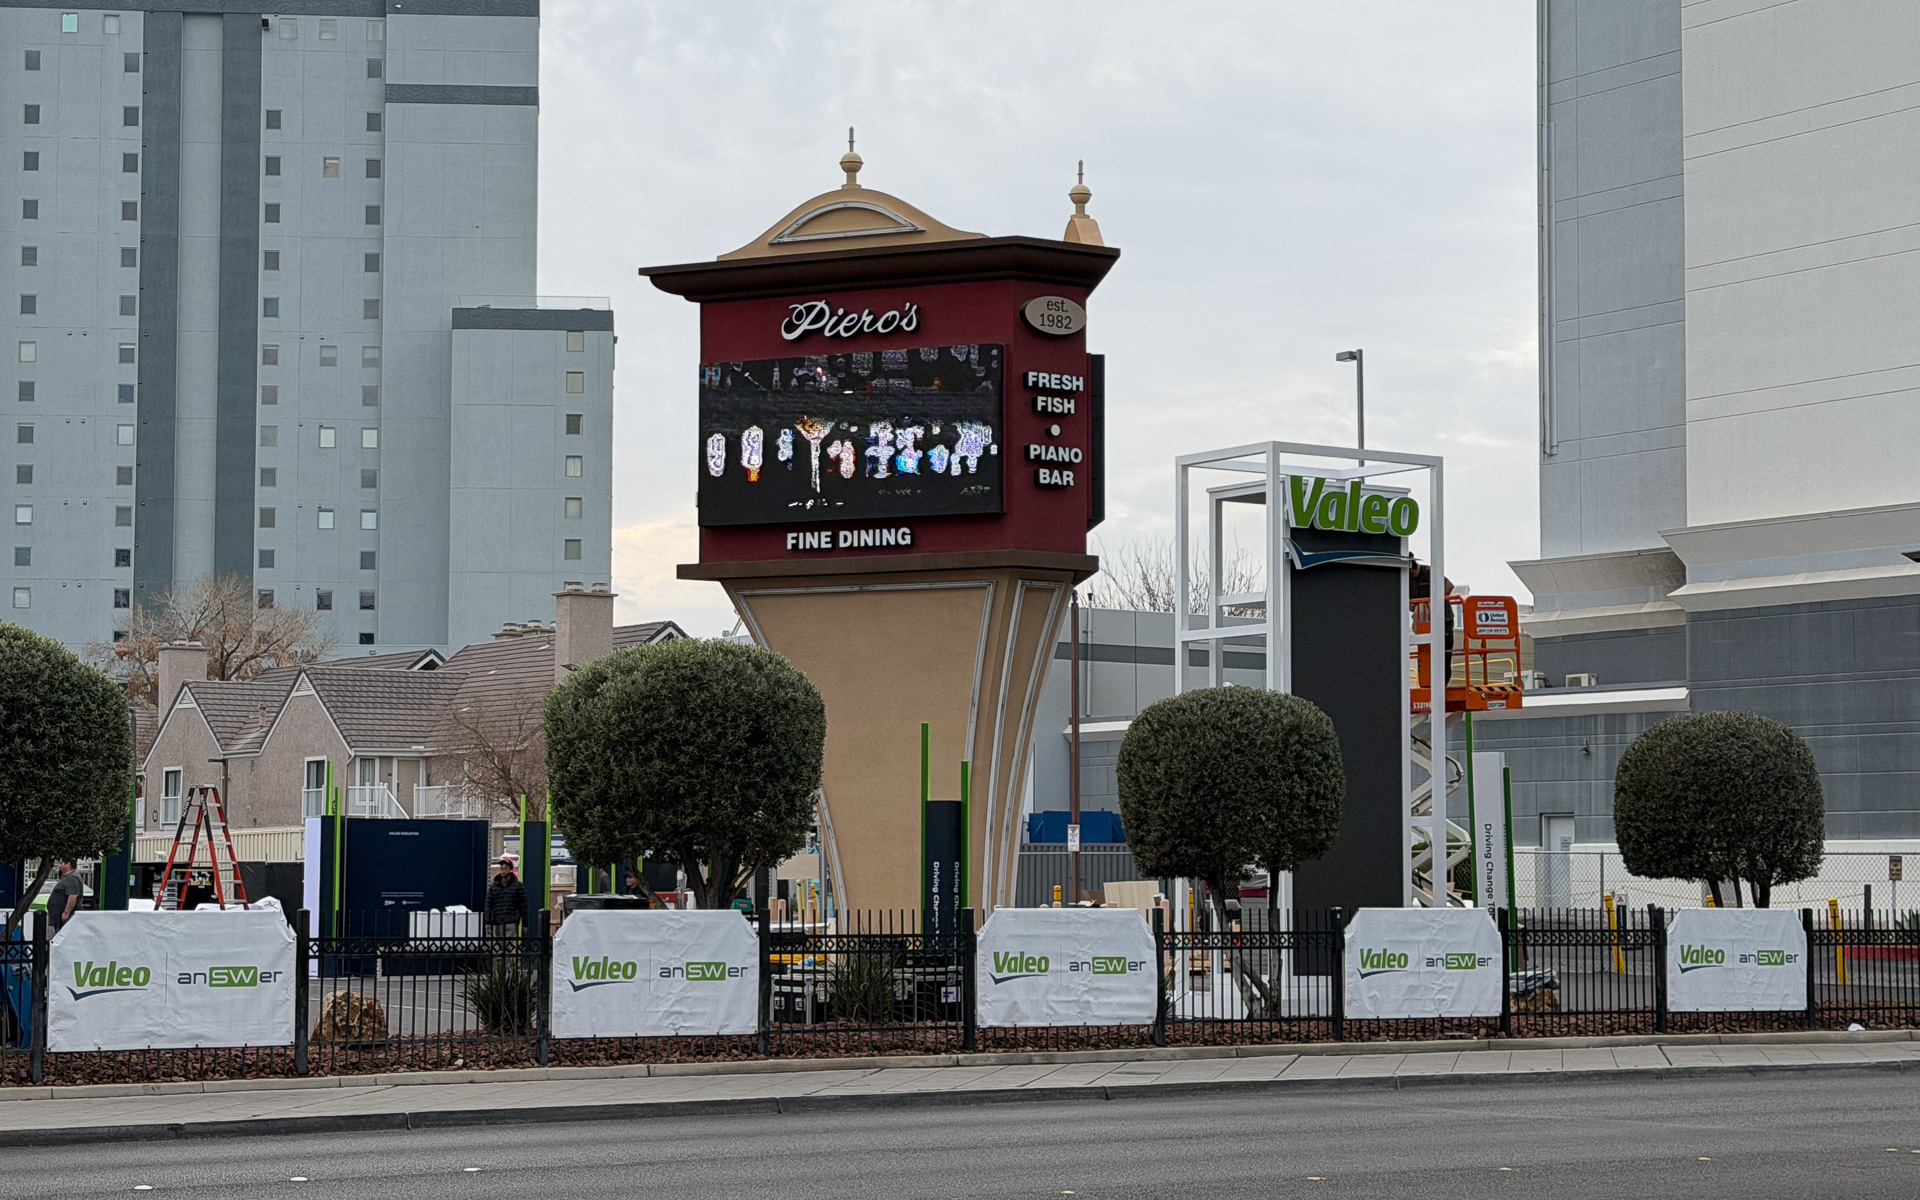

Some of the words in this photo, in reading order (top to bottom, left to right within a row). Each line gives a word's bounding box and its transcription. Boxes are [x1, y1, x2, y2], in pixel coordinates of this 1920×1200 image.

[1046, 300, 1069, 313] est.
[781, 299, 918, 340] Piero's
[1039, 312, 1073, 330] 1982
[1028, 371, 1084, 392] FRESH
[1037, 396, 1075, 414] FISH
[1029, 444, 1083, 464] PIANO
[1039, 468, 1075, 487] BAR
[1284, 474, 1420, 537] Valeo
[786, 531, 833, 550] FINE
[838, 527, 912, 548] DINING
[1483, 822, 1494, 860] Driving
[931, 861, 940, 893] Driving
[1485, 860, 1495, 900] Change
[993, 951, 1050, 973] Valeo
[1069, 957, 1147, 974] anSWer
[1359, 948, 1409, 969] Valeo
[1425, 953, 1493, 969] anSWer
[1680, 944, 1725, 964] Valeo
[1739, 950, 1799, 965] anSWer
[73, 961, 151, 988] Valeo
[177, 967, 284, 987] anSWer
[572, 956, 637, 980] Valeo
[659, 962, 749, 981] anSWer
